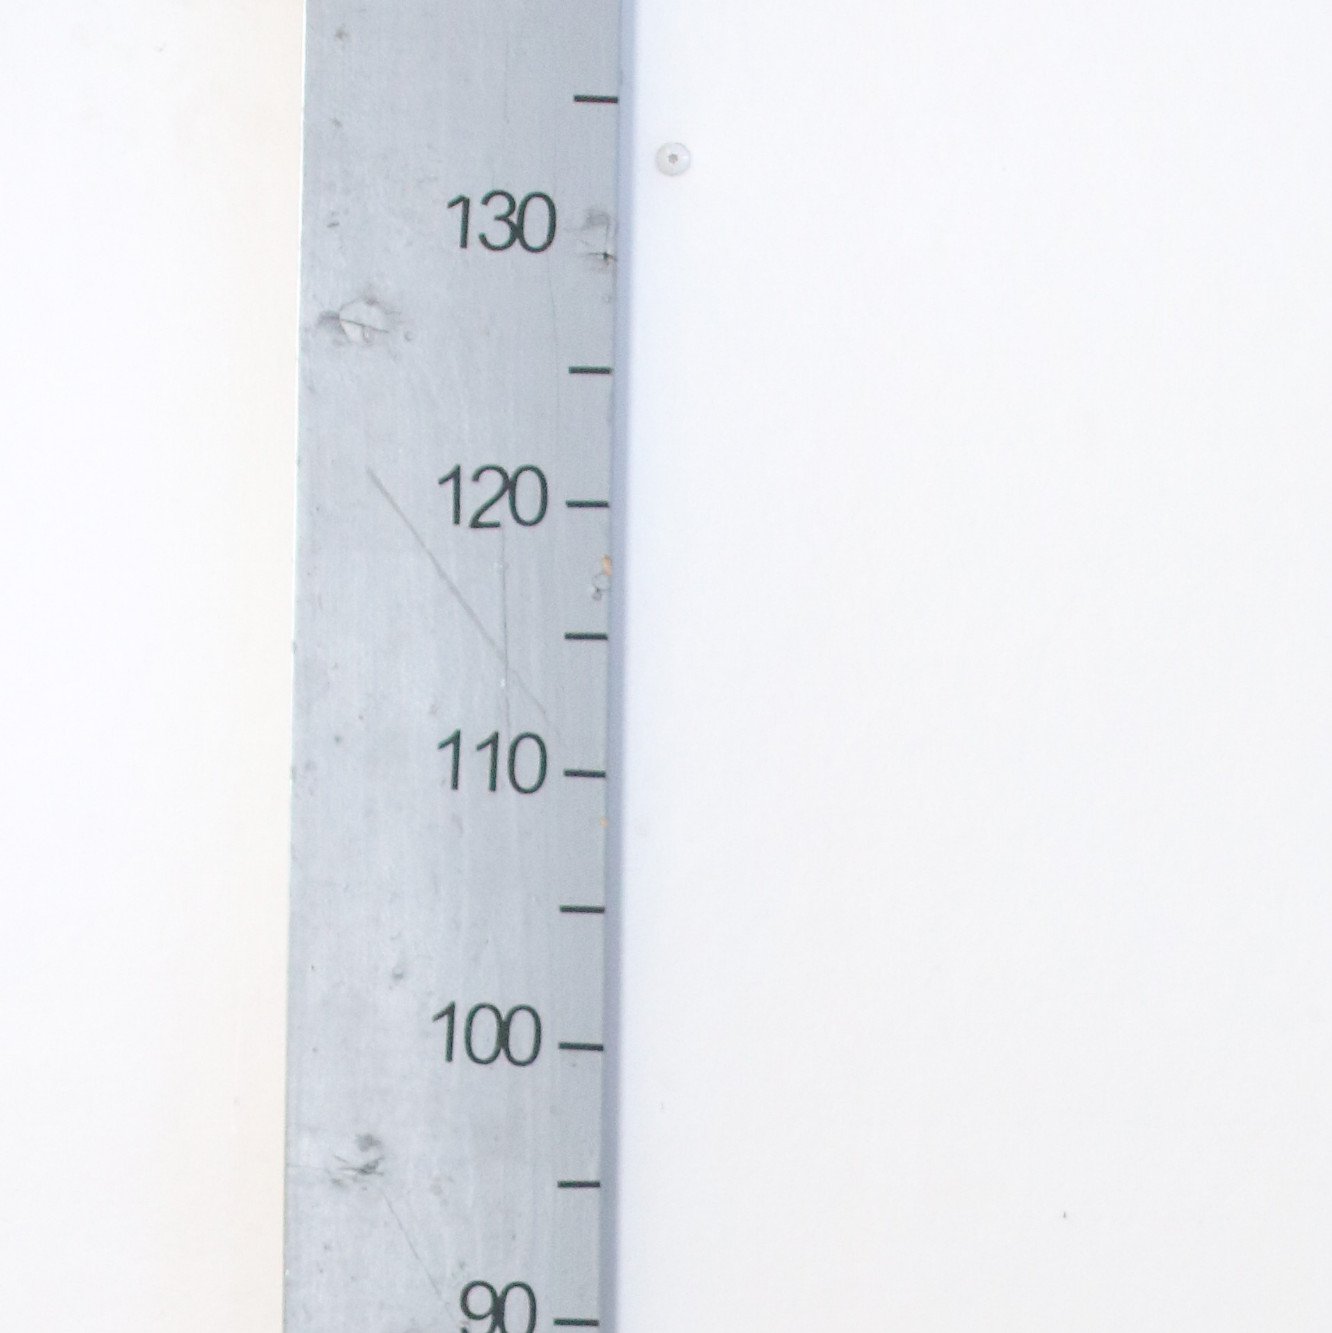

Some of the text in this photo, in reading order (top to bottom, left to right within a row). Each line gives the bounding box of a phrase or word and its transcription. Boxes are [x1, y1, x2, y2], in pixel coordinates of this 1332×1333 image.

[448, 190, 556, 253] 130
[439, 465, 548, 529] 120
[439, 730, 547, 794] 110
[434, 1002, 541, 1067] 100
